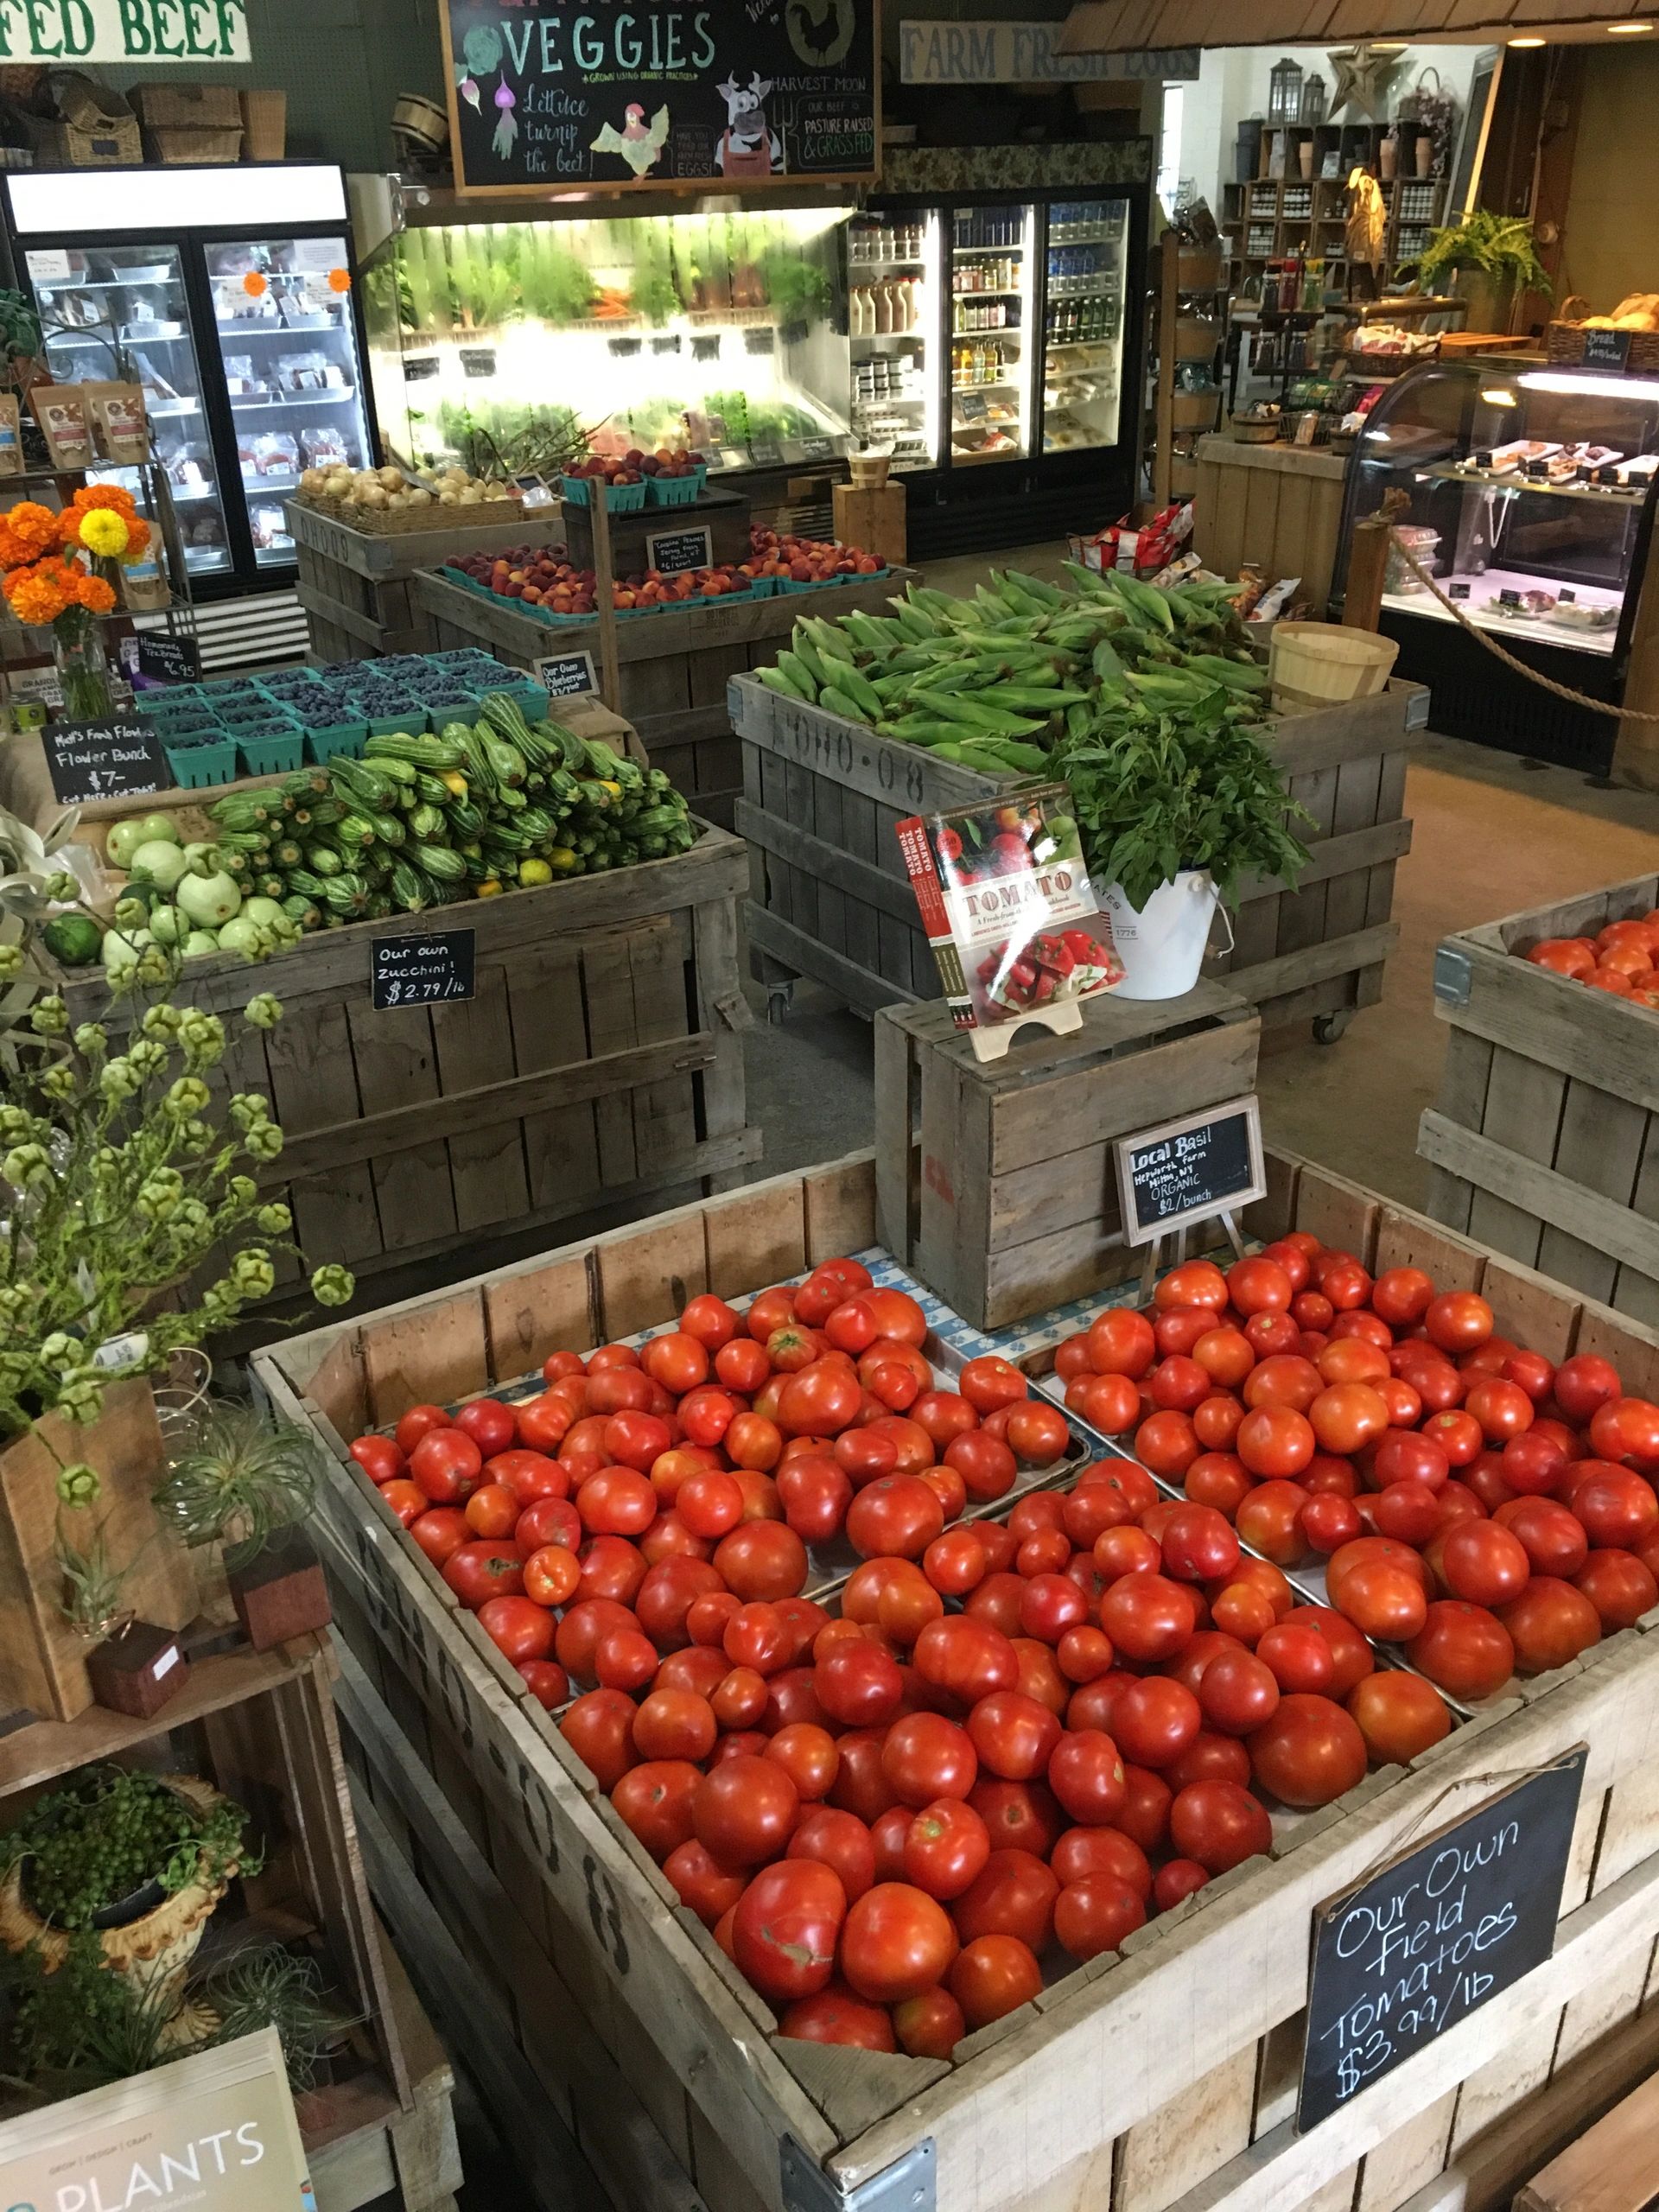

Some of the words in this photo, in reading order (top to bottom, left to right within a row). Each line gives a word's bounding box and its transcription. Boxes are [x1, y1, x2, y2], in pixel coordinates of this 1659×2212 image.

[0, 0, 95, 58] FED
[118, 0, 245, 58] BEEF
[499, 12, 715, 76] VEGGIES
[901, 27, 997, 79] FARM
[616, 72, 639, 80] USING
[771, 76, 830, 92] HARVEST
[835, 77, 865, 92] MOON
[523, 83, 589, 118] Lettuce
[808, 102, 823, 113] OUR
[826, 101, 844, 112] BEEF
[525, 120, 579, 152] turnip
[804, 118, 842, 135] PASTURE
[843, 116, 874, 134] RAISED
[524, 146, 547, 173] the
[804, 138, 816, 161] &
[1587, 330, 1616, 346] Bread
[543, 667, 559, 677] Our
[559, 663, 578, 673] Own
[545, 671, 587, 690] Blueberries
[55, 751, 108, 768] Flower
[111, 746, 151, 762] Bunch
[899, 832, 916, 876] TOMATO
[906, 830, 923, 874] TOMATO
[915, 827, 932, 872] TOMATO
[963, 871, 1073, 917] TOMATO
[1116, 929, 1137, 938] 1776
[378, 948, 410, 962] Our
[417, 945, 448, 957] own
[1130, 1141, 1171, 1173] Local
[1174, 1126, 1212, 1159] Basil
[1135, 1160, 1179, 1185] Hepworth
[1179, 1164, 1193, 1178] NY
[1150, 1173, 1201, 1201] ORGANIC
[1158, 1188, 1212, 1217] $2/bunch
[1336, 1881, 1420, 1958] Our
[1426, 1821, 1520, 1898] Own
[1365, 1885, 1467, 1977] Field
[1335, 1972, 1494, 2099] $3.99/lb
[124, 2132, 154, 2149] CRAFT
[55, 2121, 265, 2212] PLANTS
